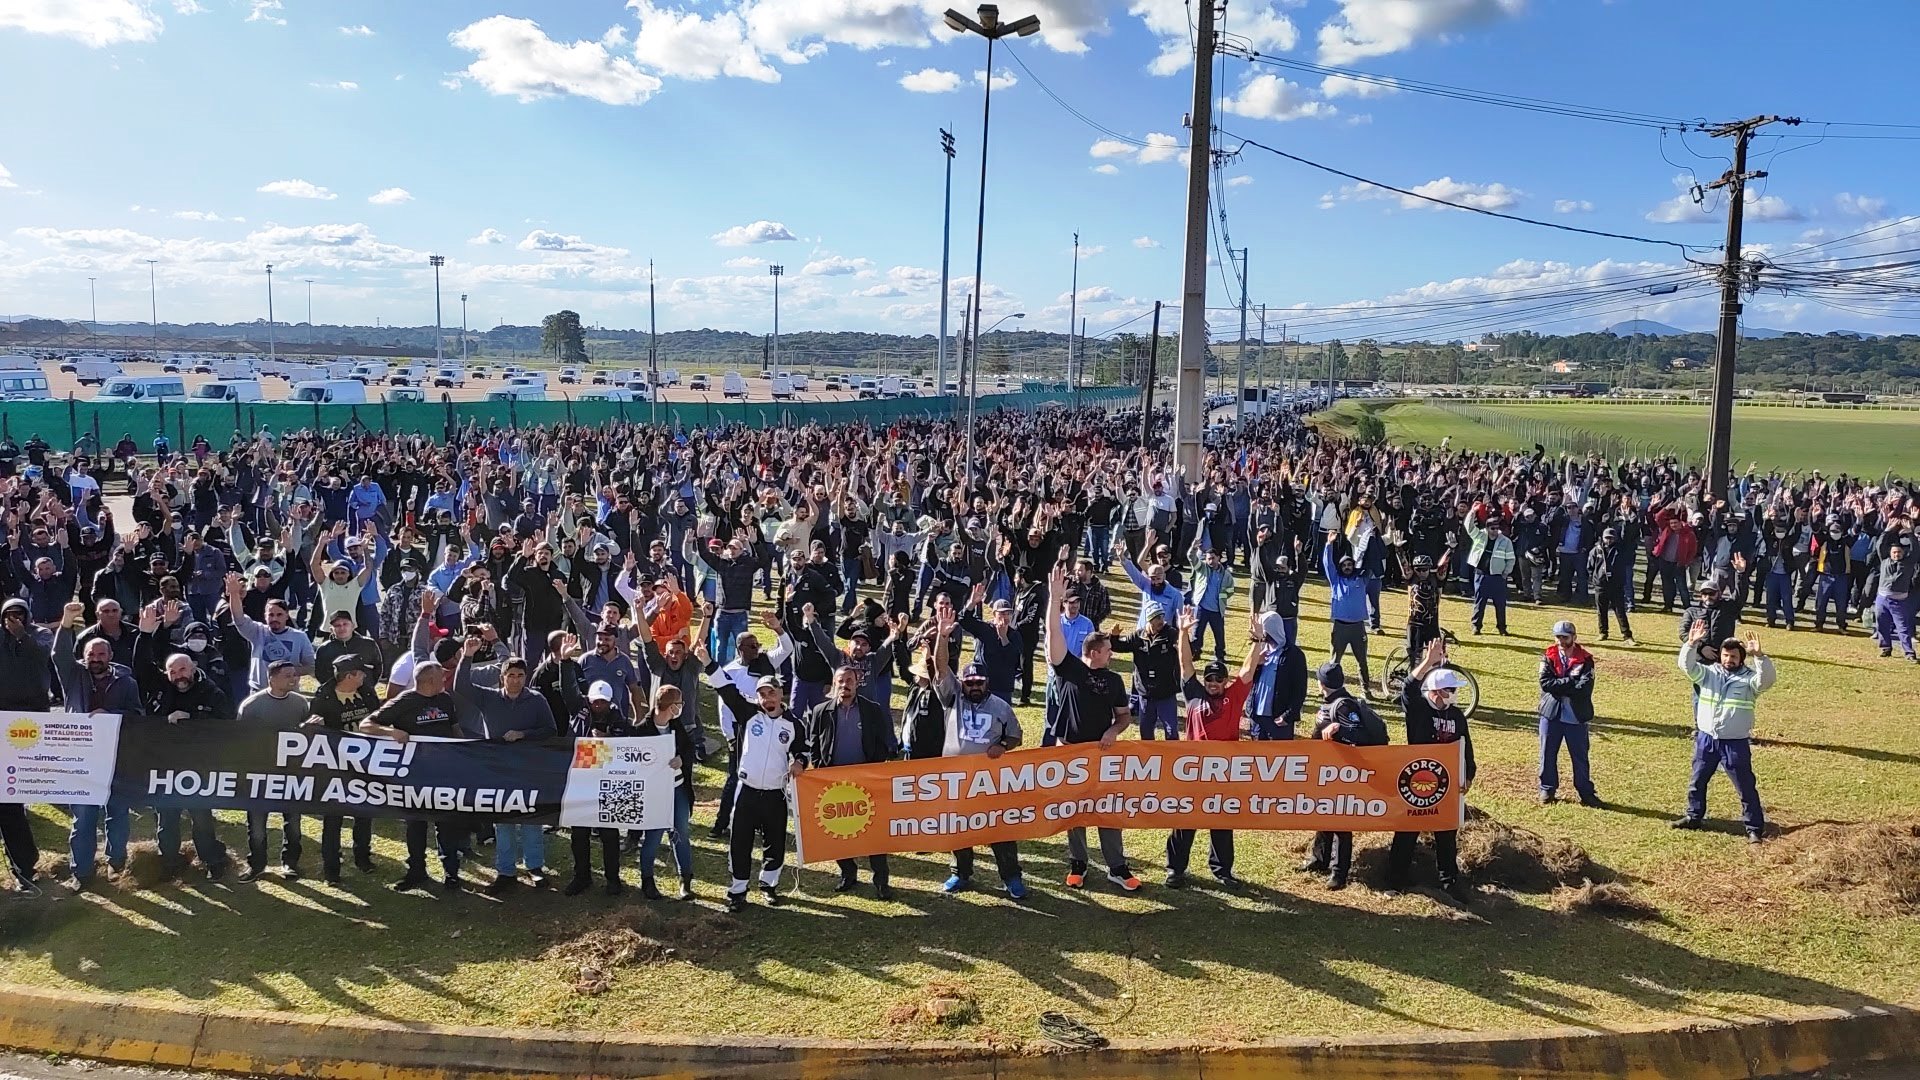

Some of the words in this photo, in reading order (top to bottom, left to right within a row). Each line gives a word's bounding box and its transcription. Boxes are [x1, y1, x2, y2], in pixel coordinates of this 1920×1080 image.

[10, 729, 37, 738] SMC
[17, 753, 85, 762] www.simec.com.br
[276, 731, 416, 777] PARE!
[624, 752, 652, 763] SMC
[1404, 760, 1443, 776] FORÇA
[891, 756, 1089, 803] ESTAMOS
[1099, 754, 1162, 782] EM
[1171, 754, 1309, 783] GREVE
[1317, 764, 1376, 787] por
[17, 789, 91, 797] /metalurgicosdecuritiba
[148, 769, 237, 798] HOJE
[246, 773, 314, 802] TEM
[321, 777, 539, 813] ASSEMBLEIA!
[1400, 786, 1446, 806] SINDICAL
[822, 799, 869, 820] SMC
[889, 805, 1036, 837] melhores
[1043, 792, 1194, 821] condições
[1201, 793, 1242, 815] de
[1249, 793, 1388, 818] trabalho
[1407, 807, 1439, 817] PARANÁ
